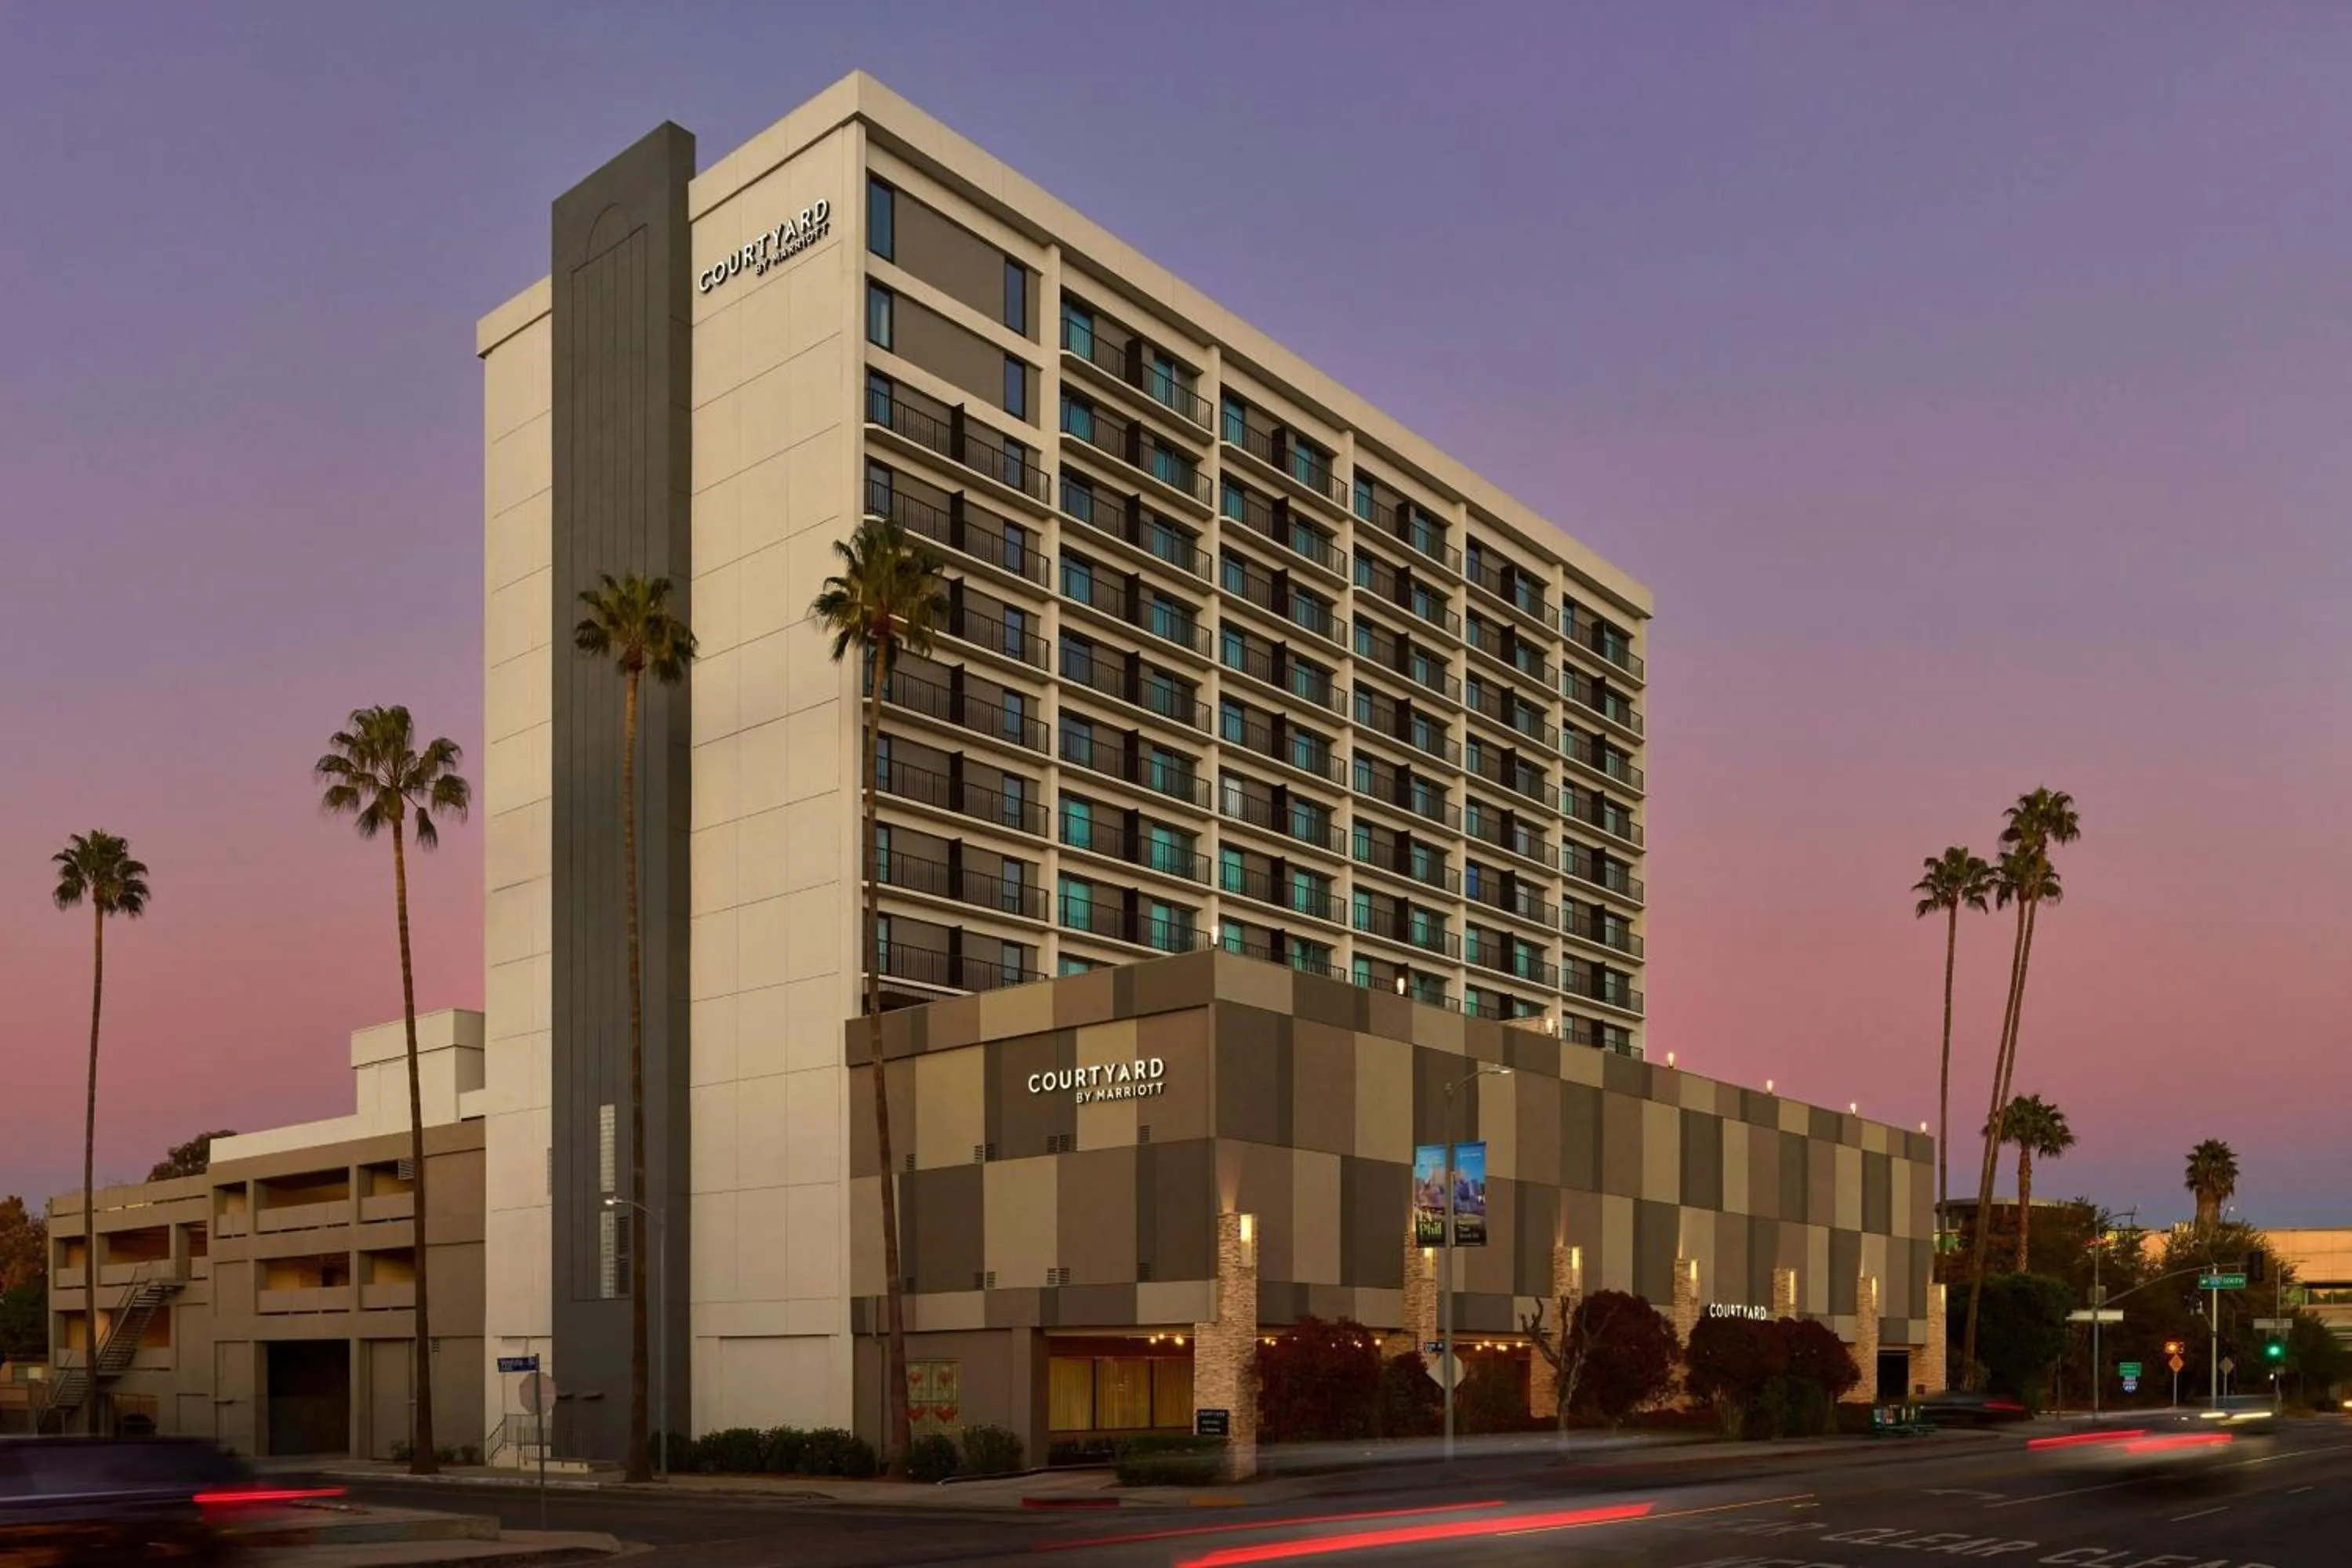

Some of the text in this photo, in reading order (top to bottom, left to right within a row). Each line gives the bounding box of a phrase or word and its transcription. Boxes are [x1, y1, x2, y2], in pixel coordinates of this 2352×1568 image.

[699, 198, 829, 293] COURTYARD
[756, 222, 829, 276] BY MARRIOTT
[1028, 1058, 1165, 1093] COURTYARD
[1076, 1082, 1164, 1104] BY MARRIOTT
[1710, 1303, 1766, 1320] COURTYARD
[1818, 1528, 2038, 1557] CLEAR
[2038, 1547, 2275, 1568] CLE
